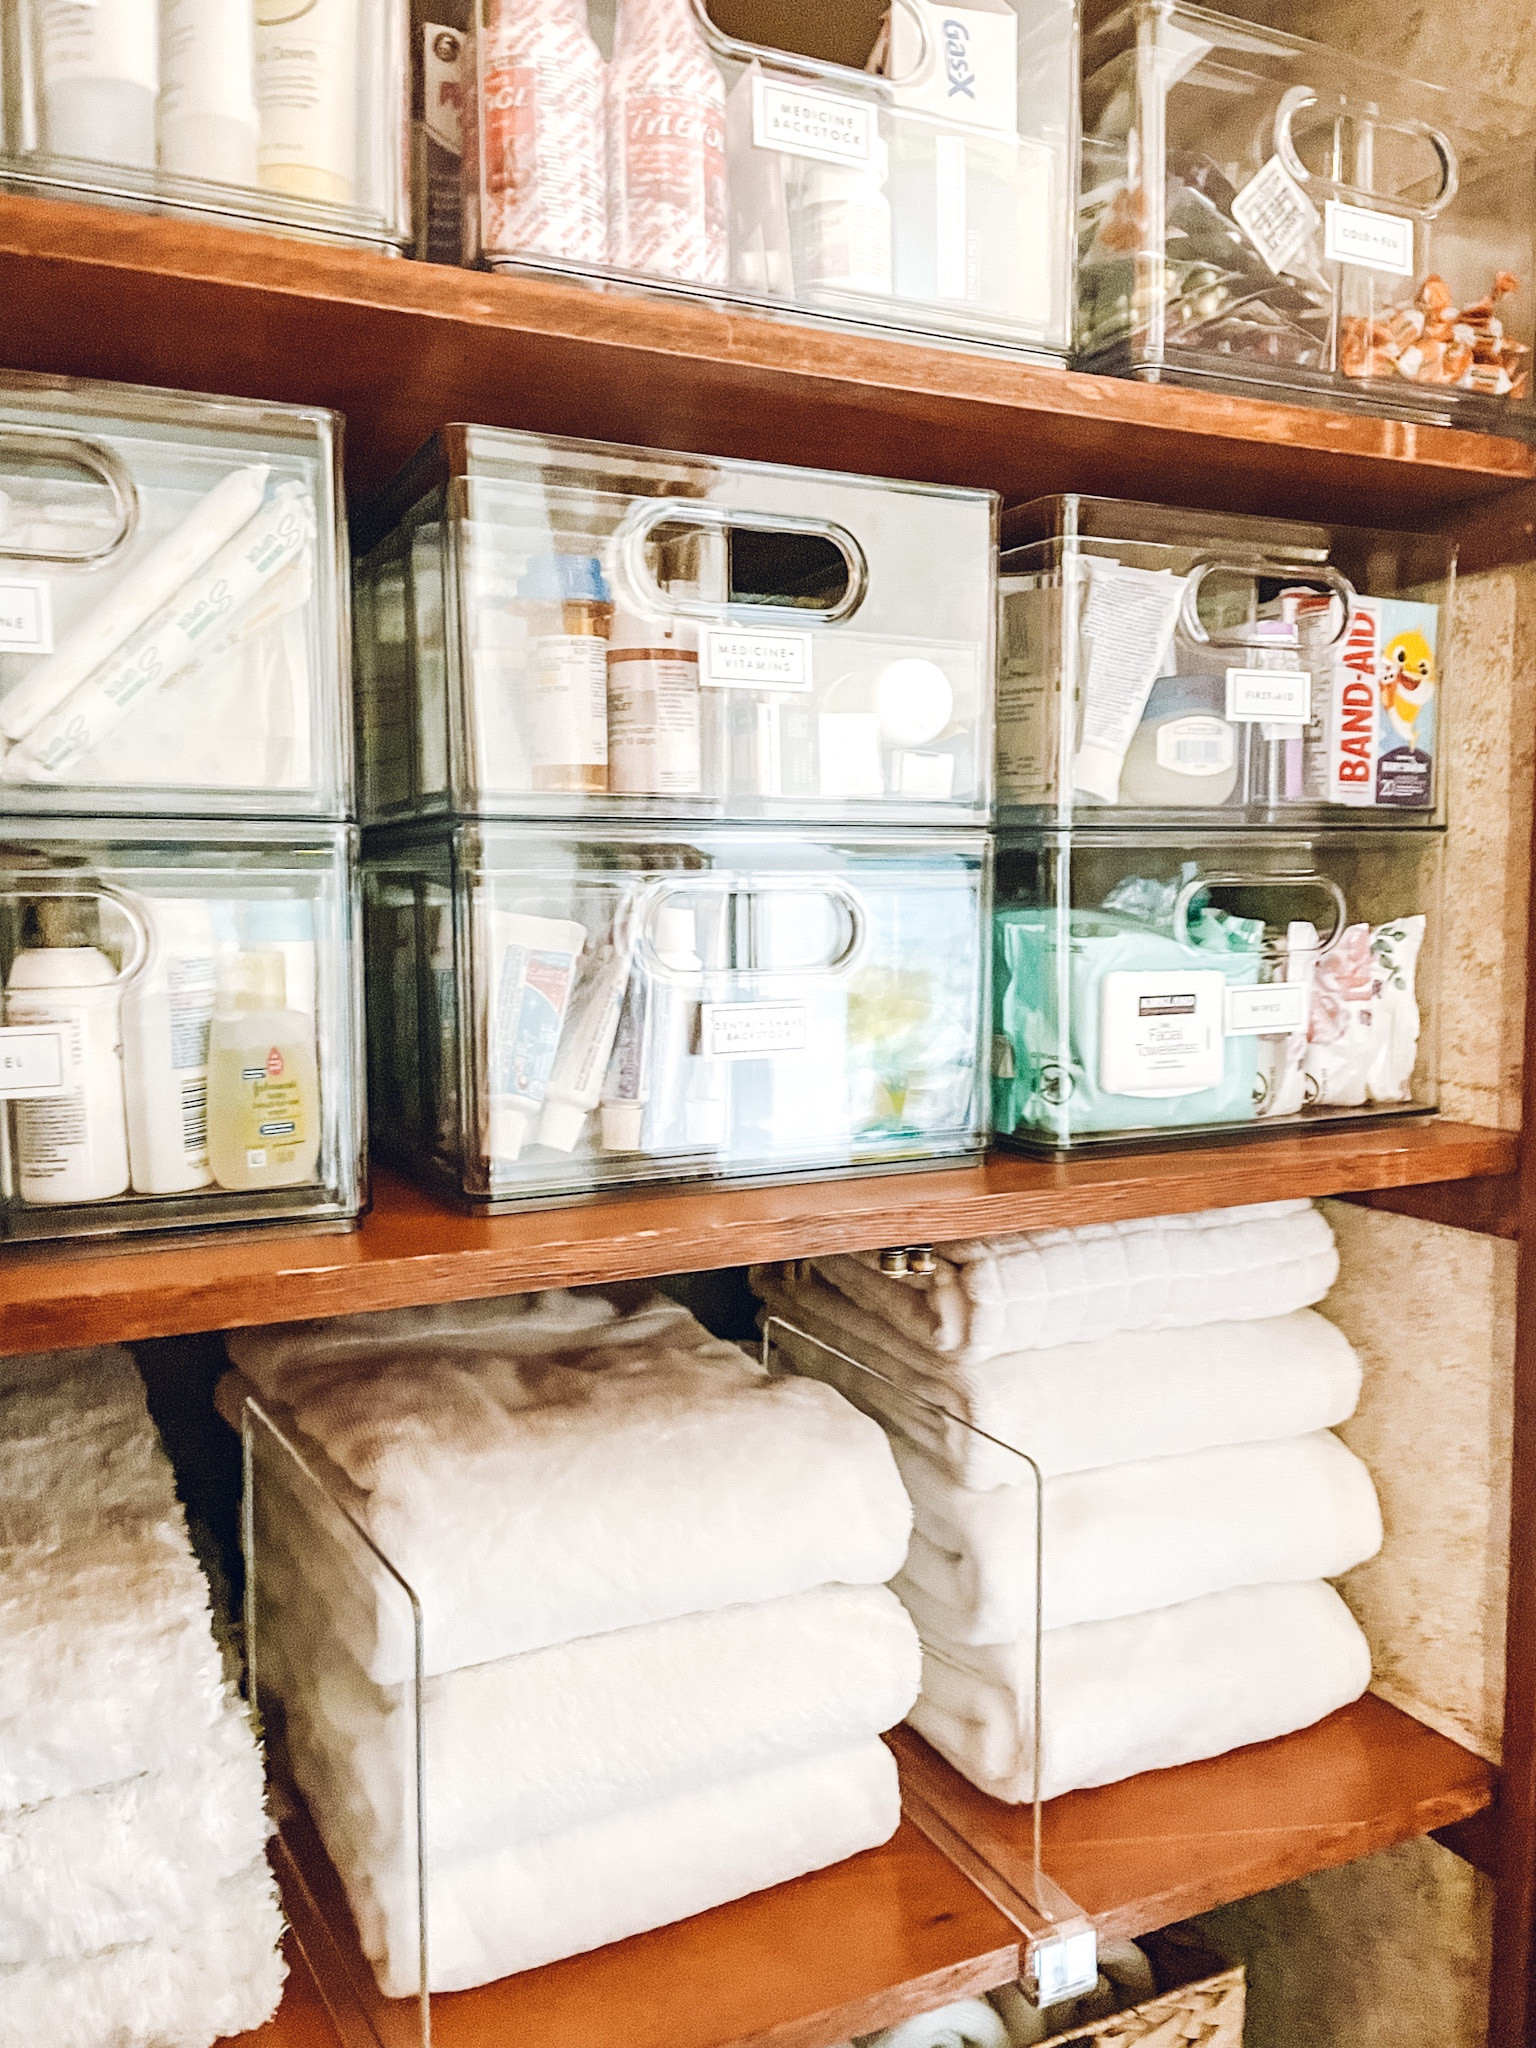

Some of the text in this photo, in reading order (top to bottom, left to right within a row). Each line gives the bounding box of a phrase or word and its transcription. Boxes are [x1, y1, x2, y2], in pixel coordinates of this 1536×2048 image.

[943, 19, 975, 99] Gas-X
[781, 104, 853, 129] MEDICINE
[773, 117, 860, 144] BACKSTOCK
[725, 660, 791, 672] VITAMINS
[1338, 612, 1375, 782] BAND-AID
[1148, 1027, 1183, 1041] Facial
[1135, 1043, 1199, 1056] Towelettes
